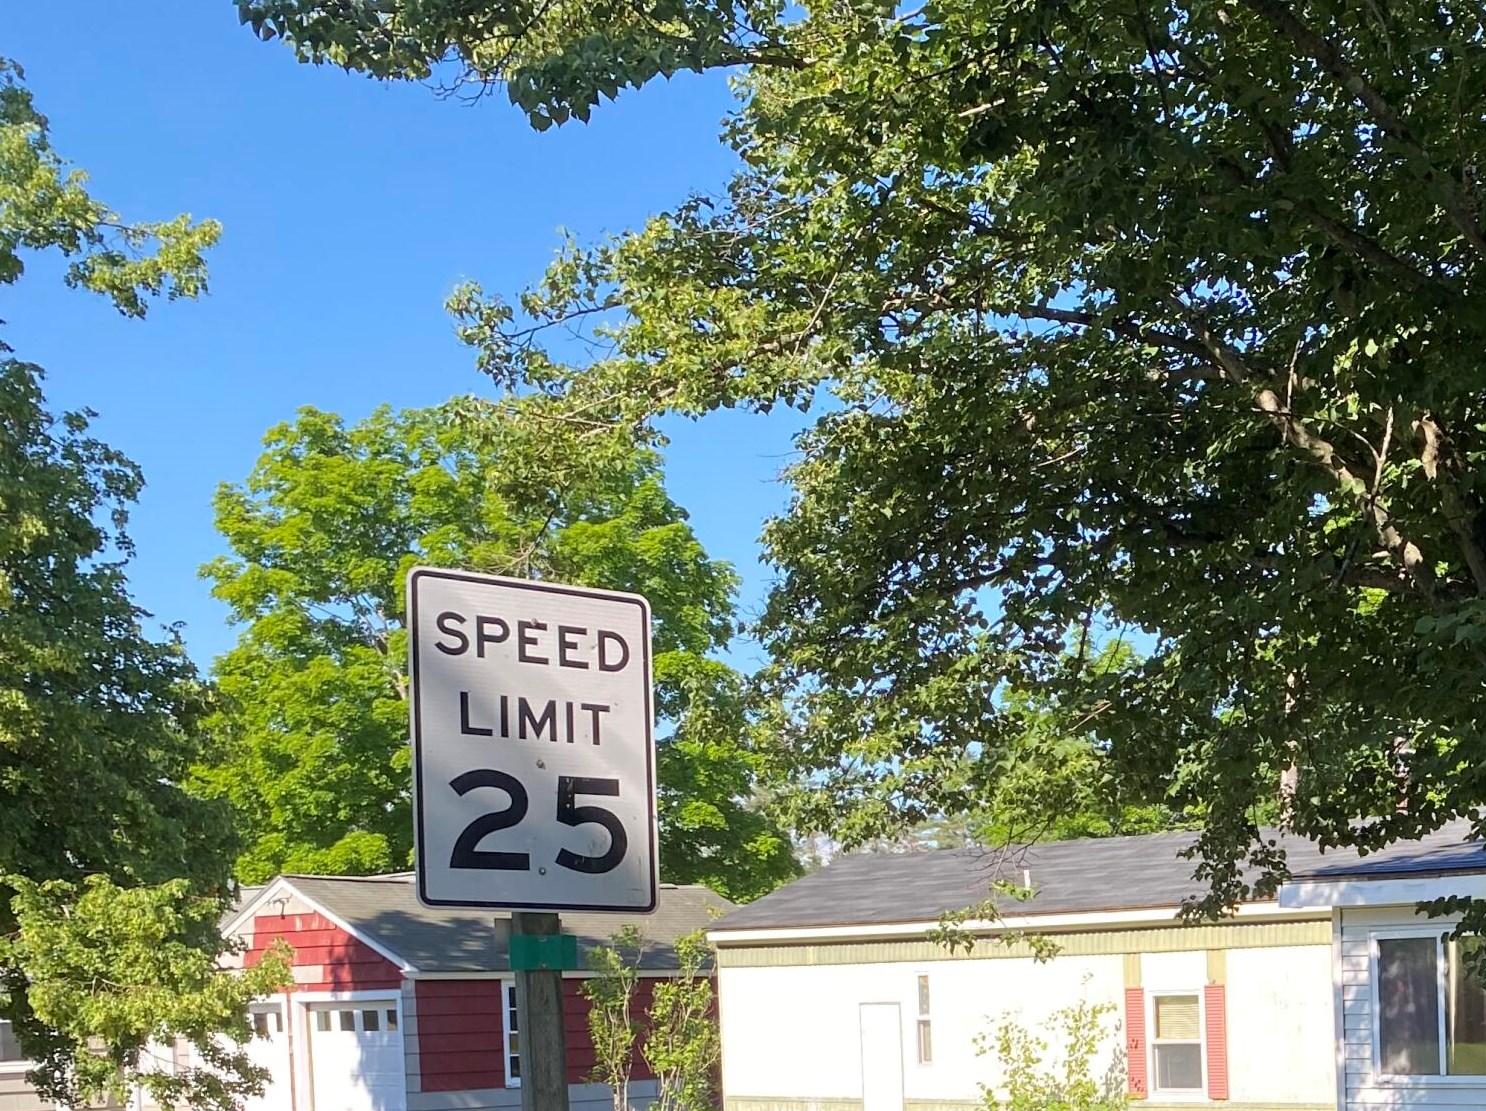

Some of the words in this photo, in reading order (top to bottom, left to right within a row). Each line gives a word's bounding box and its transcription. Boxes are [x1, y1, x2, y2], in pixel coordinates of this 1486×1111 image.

[435, 611, 630, 672] SPEED
[460, 691, 610, 745] LIMIT
[449, 769, 628, 874] 25
